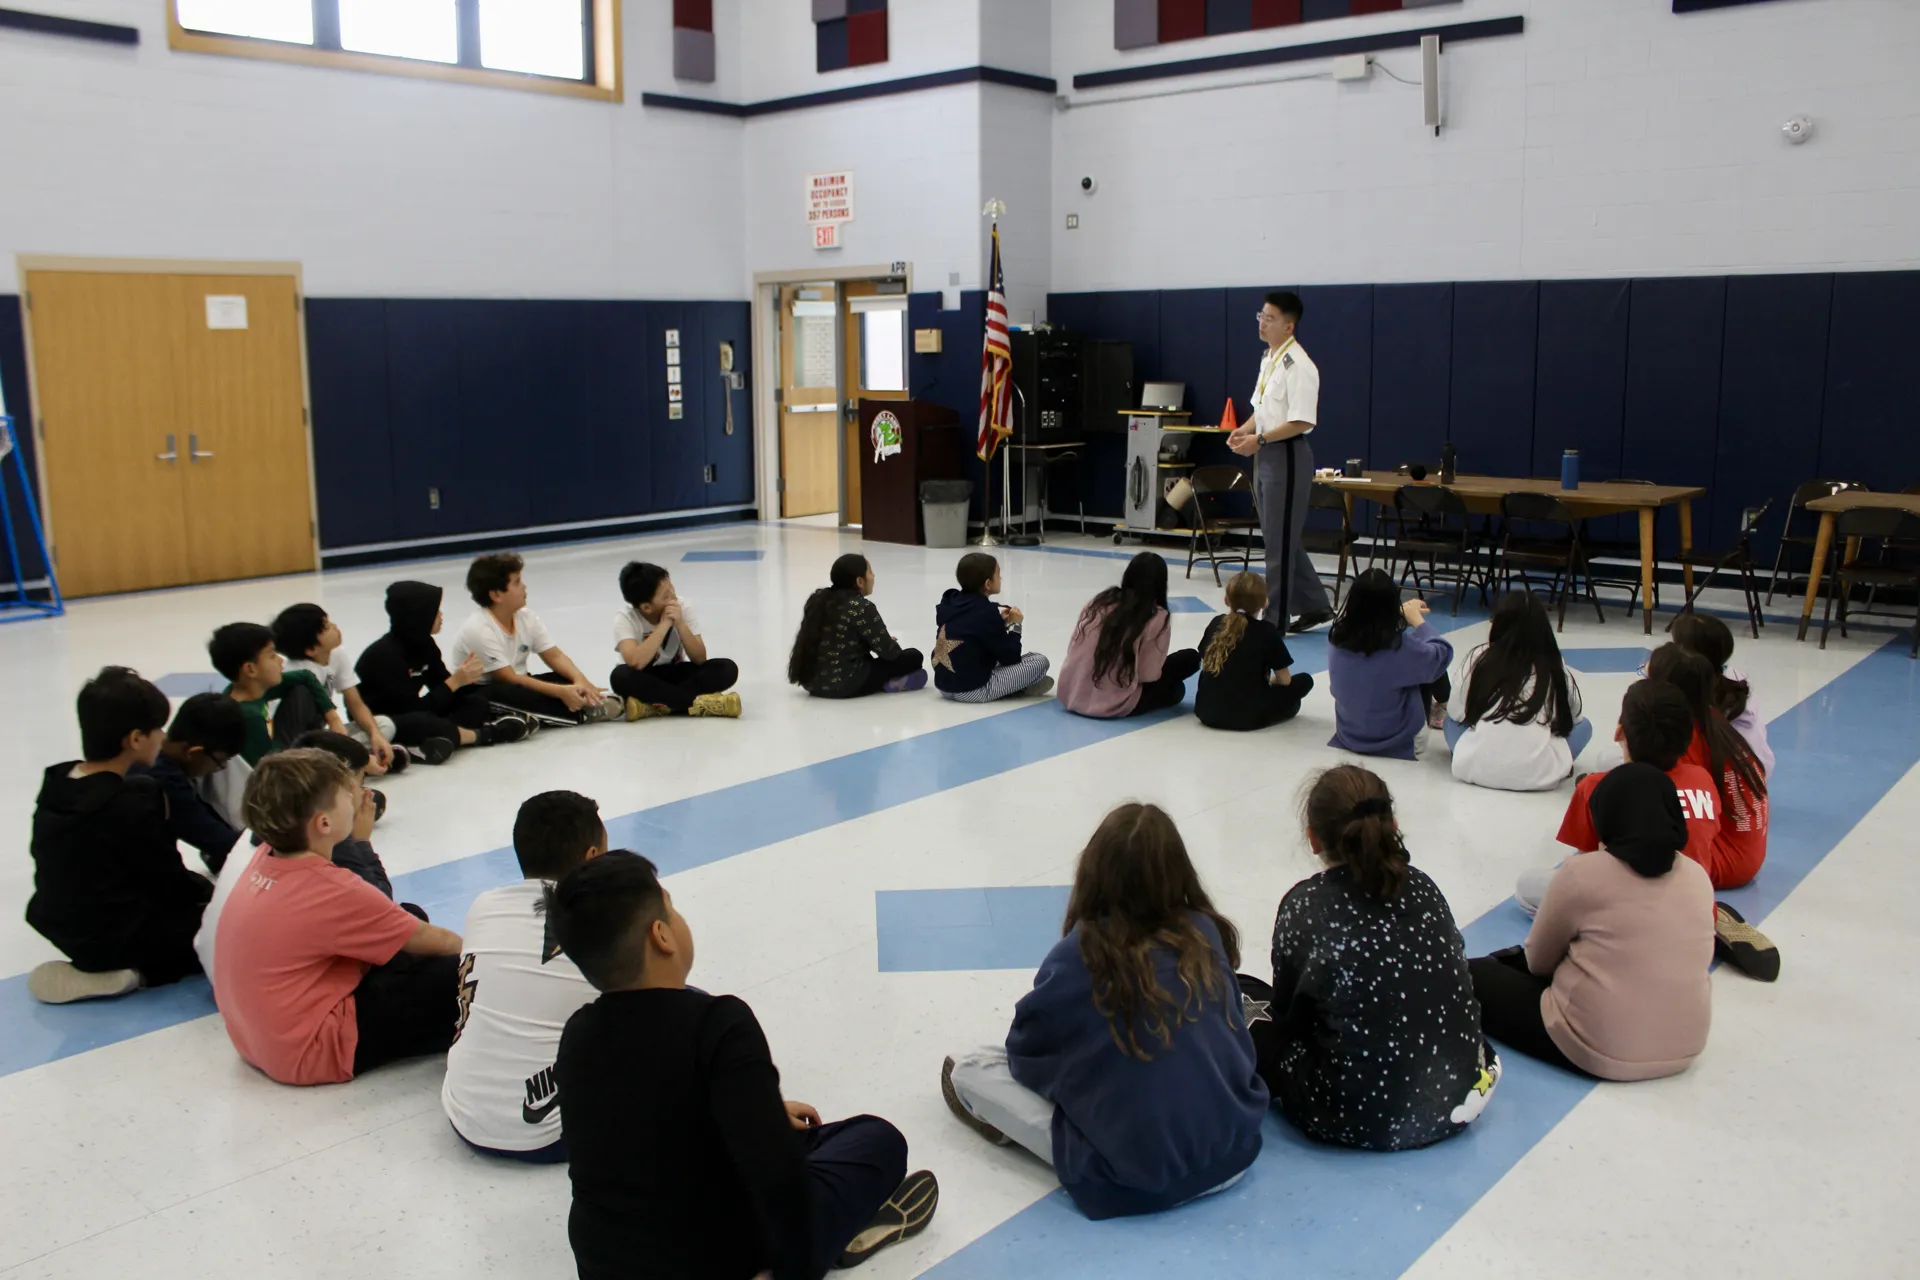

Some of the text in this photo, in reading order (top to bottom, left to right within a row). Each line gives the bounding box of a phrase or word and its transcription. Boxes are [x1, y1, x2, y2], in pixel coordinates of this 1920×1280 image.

[813, 175, 845, 187] MAXIMUM
[810, 187, 848, 200] OCCUPANCY
[821, 208, 849, 219] PERSONS
[816, 225, 835, 247] EXIT
[891, 261, 906, 273] APR
[1676, 789, 1715, 820] EW
[525, 1065, 557, 1106] NIK
